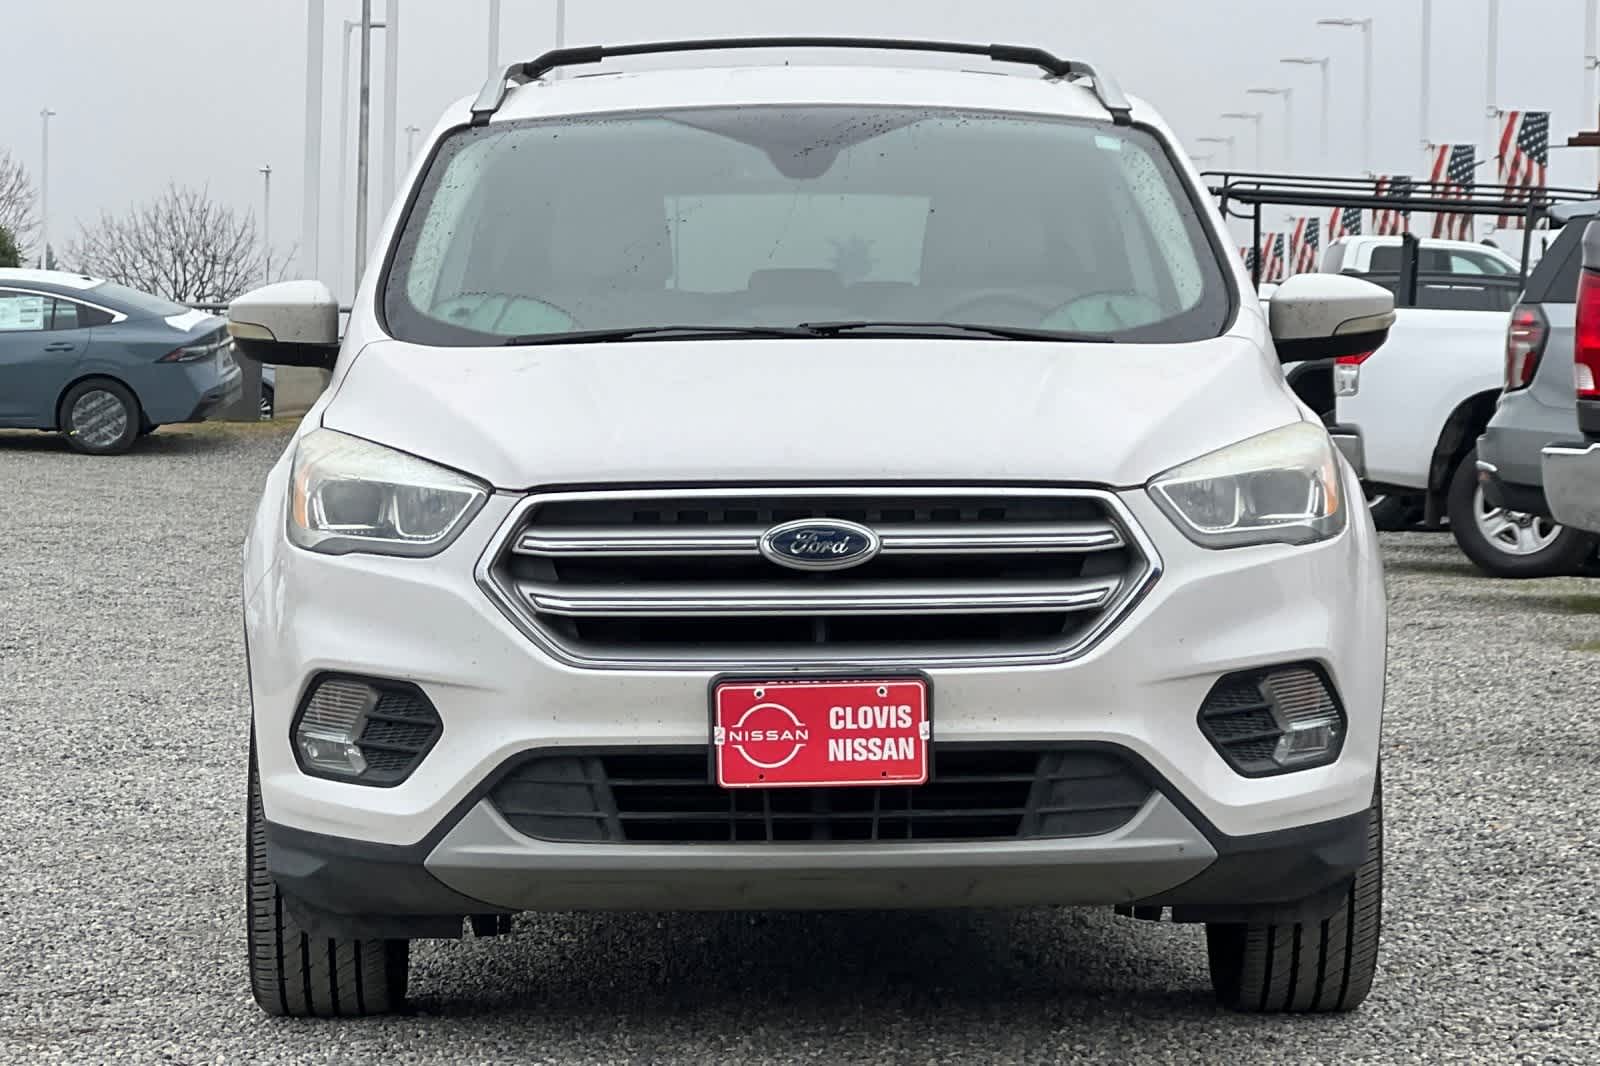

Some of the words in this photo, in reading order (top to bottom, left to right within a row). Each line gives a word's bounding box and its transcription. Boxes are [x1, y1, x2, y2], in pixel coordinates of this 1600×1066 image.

[790, 530, 850, 553] Ford
[829, 704, 912, 730] CLOVIS
[729, 729, 809, 742] NISSAN
[828, 737, 915, 762] NISSAN
